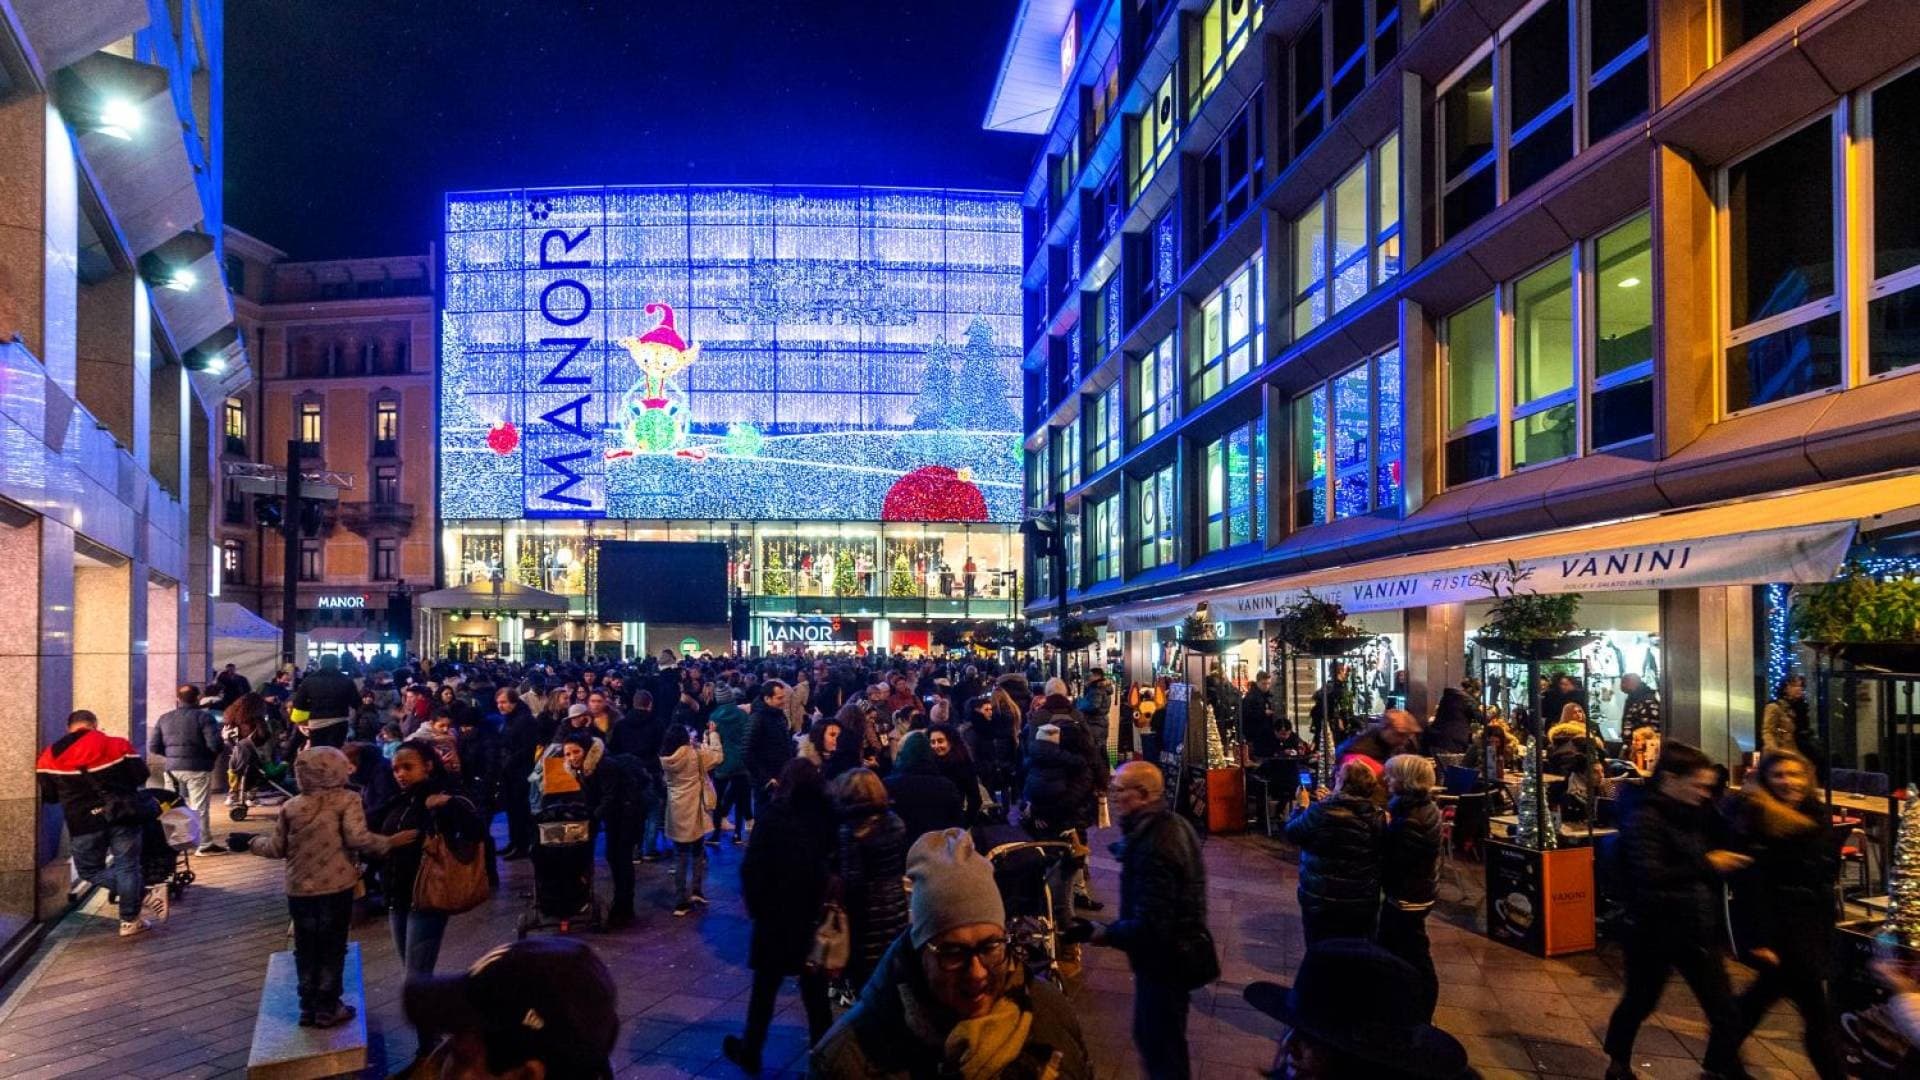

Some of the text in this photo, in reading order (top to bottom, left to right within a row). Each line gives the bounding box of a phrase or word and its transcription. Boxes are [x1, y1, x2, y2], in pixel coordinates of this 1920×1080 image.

[538, 226, 593, 508] MANOR
[318, 596, 365, 608] MANOR
[1238, 595, 1277, 611] VANINI
[1354, 579, 1418, 600] VANINI
[1561, 547, 1691, 578] VANINI
